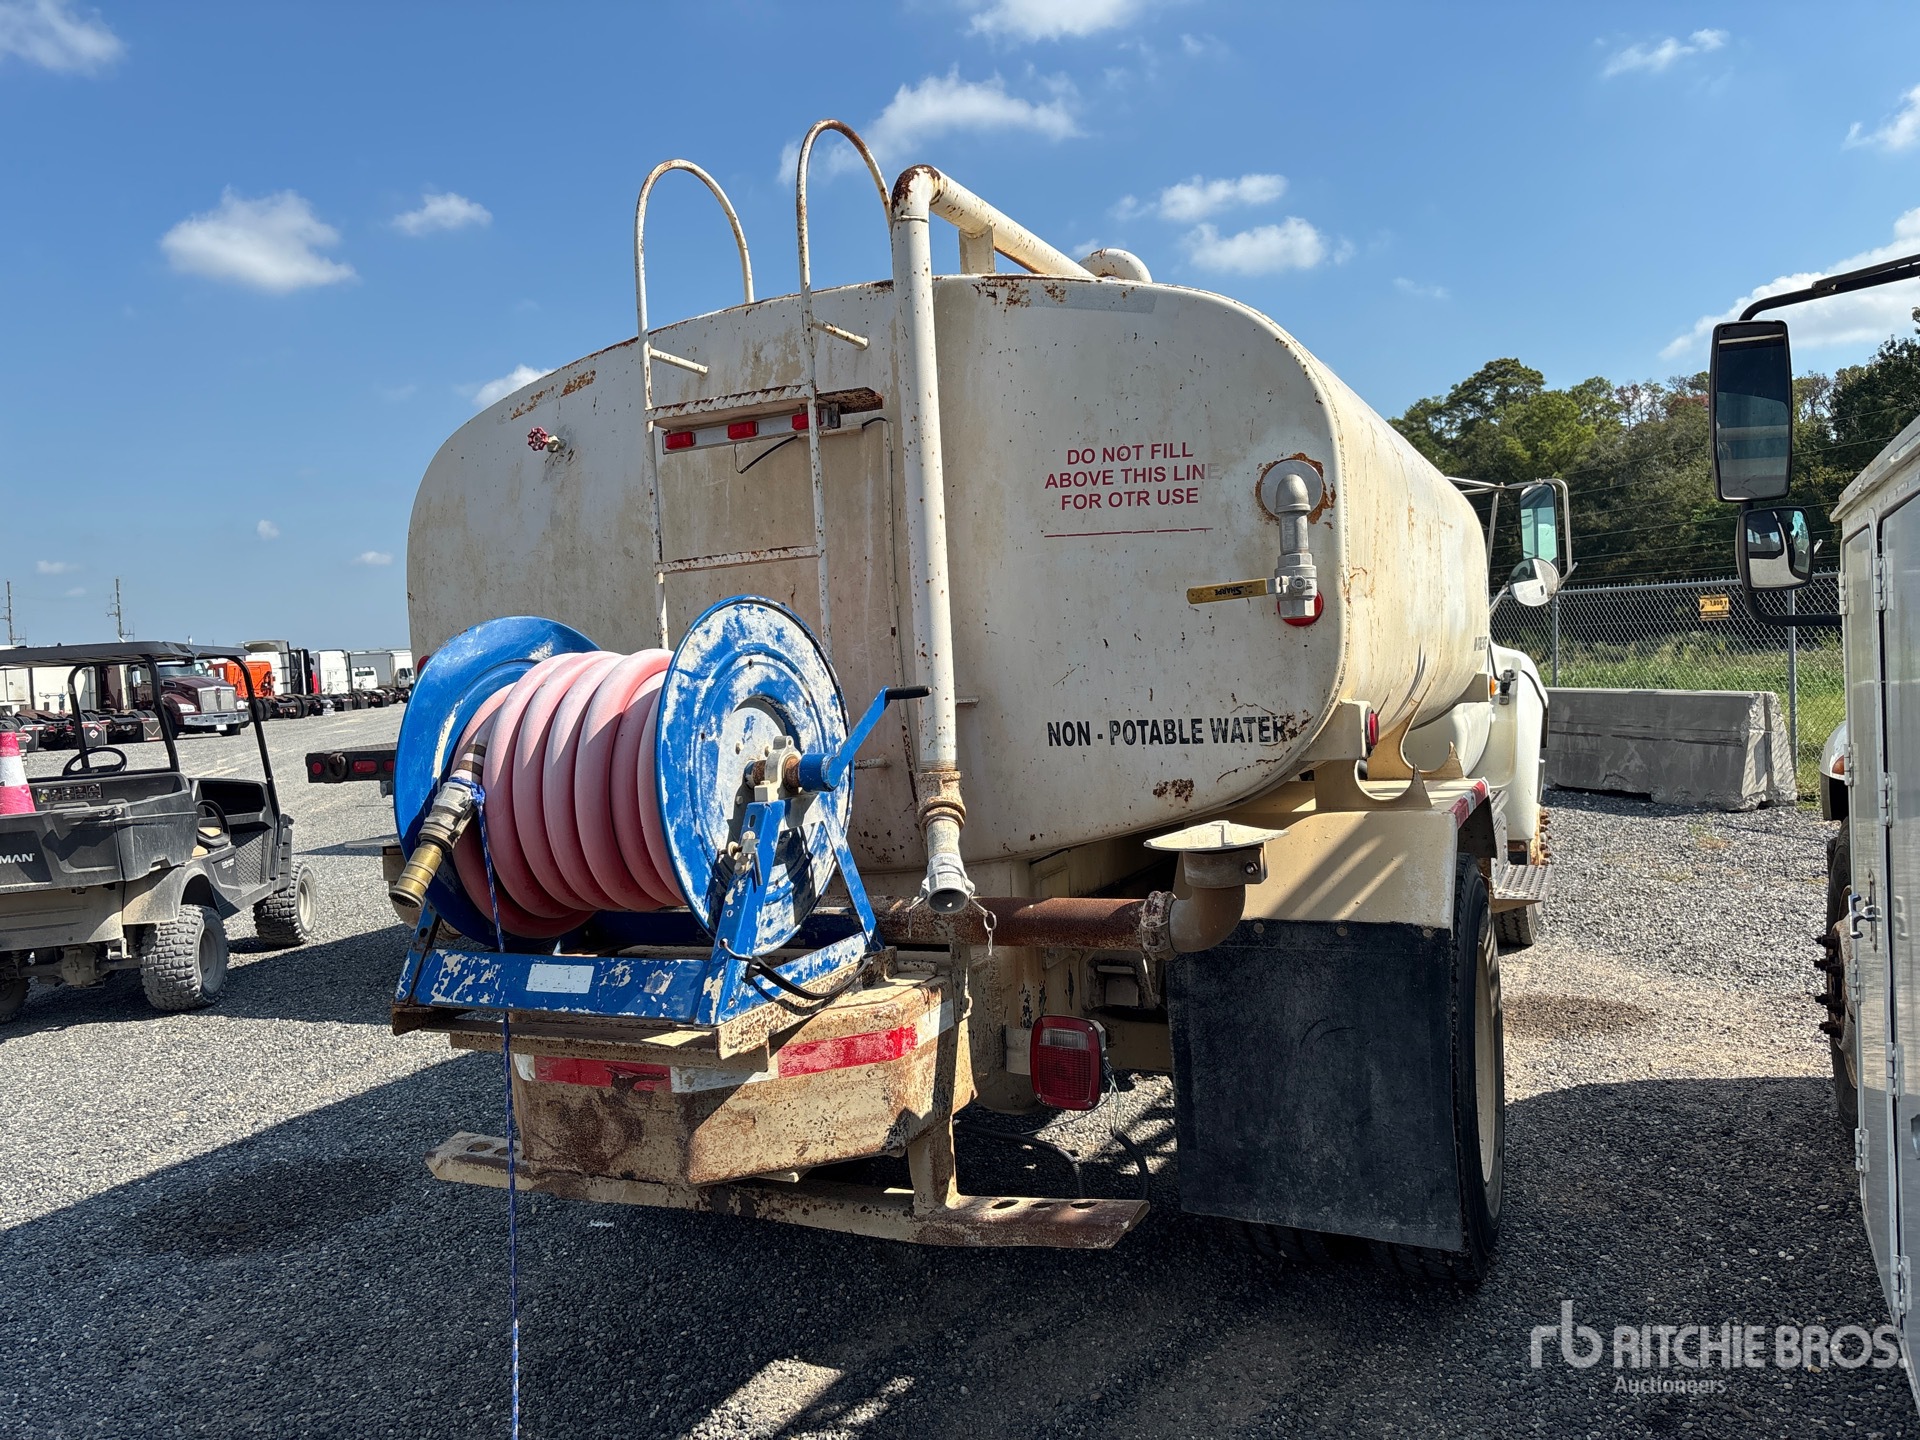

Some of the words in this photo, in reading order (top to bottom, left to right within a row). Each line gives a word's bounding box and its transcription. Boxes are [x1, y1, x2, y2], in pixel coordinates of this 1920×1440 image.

[1067, 448, 1096, 465] DO
[1102, 444, 1144, 463] NOT
[1151, 442, 1194, 459] FILL
[1044, 469, 1114, 489] ABOVE
[1120, 466, 1167, 484] THIS
[1061, 493, 1103, 511] FOR
[1108, 490, 1151, 508] OTR
[1157, 487, 1199, 505] USE
[1047, 720, 1091, 747] NON
[1108, 718, 1204, 746] POTABLE
[1209, 715, 1288, 744] WATER
